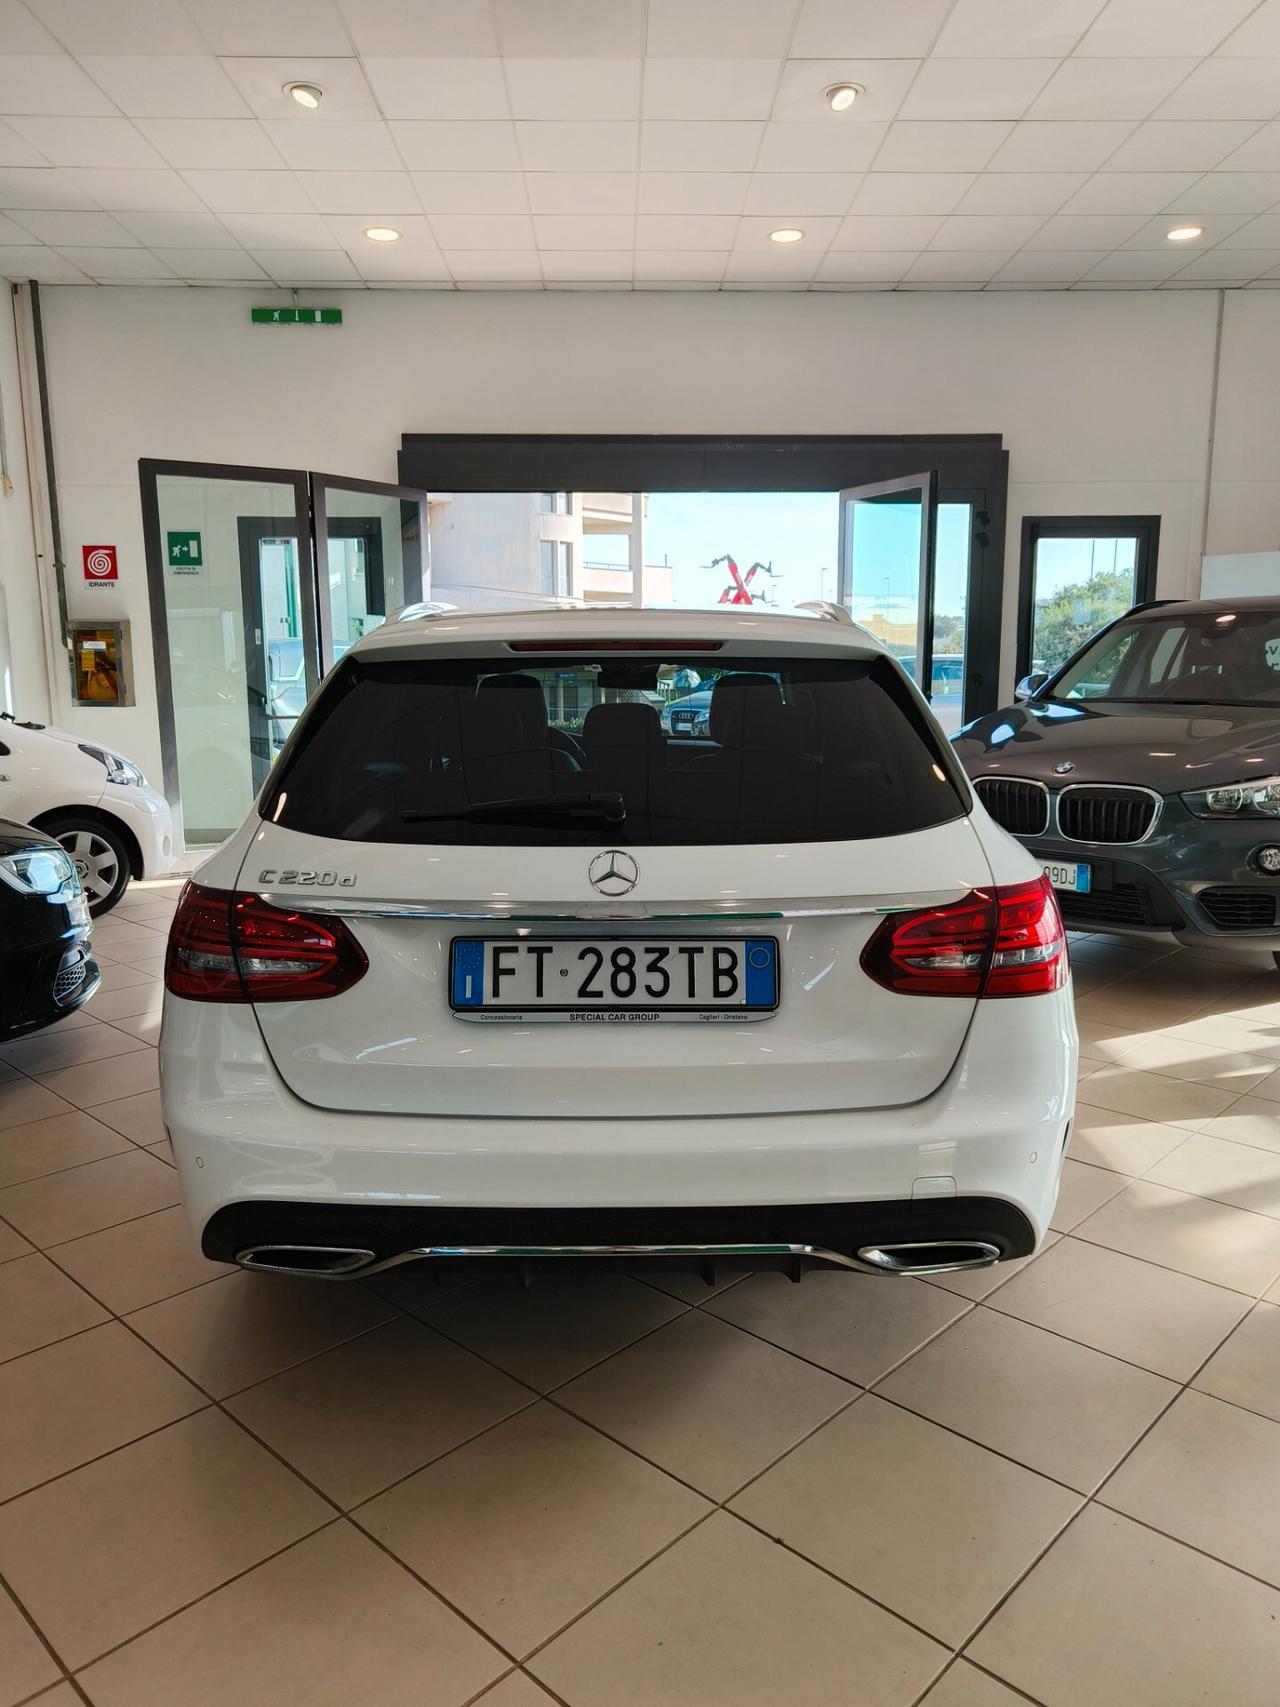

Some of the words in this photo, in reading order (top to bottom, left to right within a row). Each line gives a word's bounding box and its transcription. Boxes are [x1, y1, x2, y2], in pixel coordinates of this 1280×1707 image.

[492, 946, 554, 998] FT
[577, 946, 739, 998] 283TB
[480, 1013, 523, 1021] Concessionaria
[569, 1013, 606, 1021] SPECIAL
[607, 1013, 626, 1021] CAR
[628, 1013, 660, 1021] GROUP
[699, 1013, 720, 1021] Cagliari
[724, 1013, 748, 1021] Oristano
